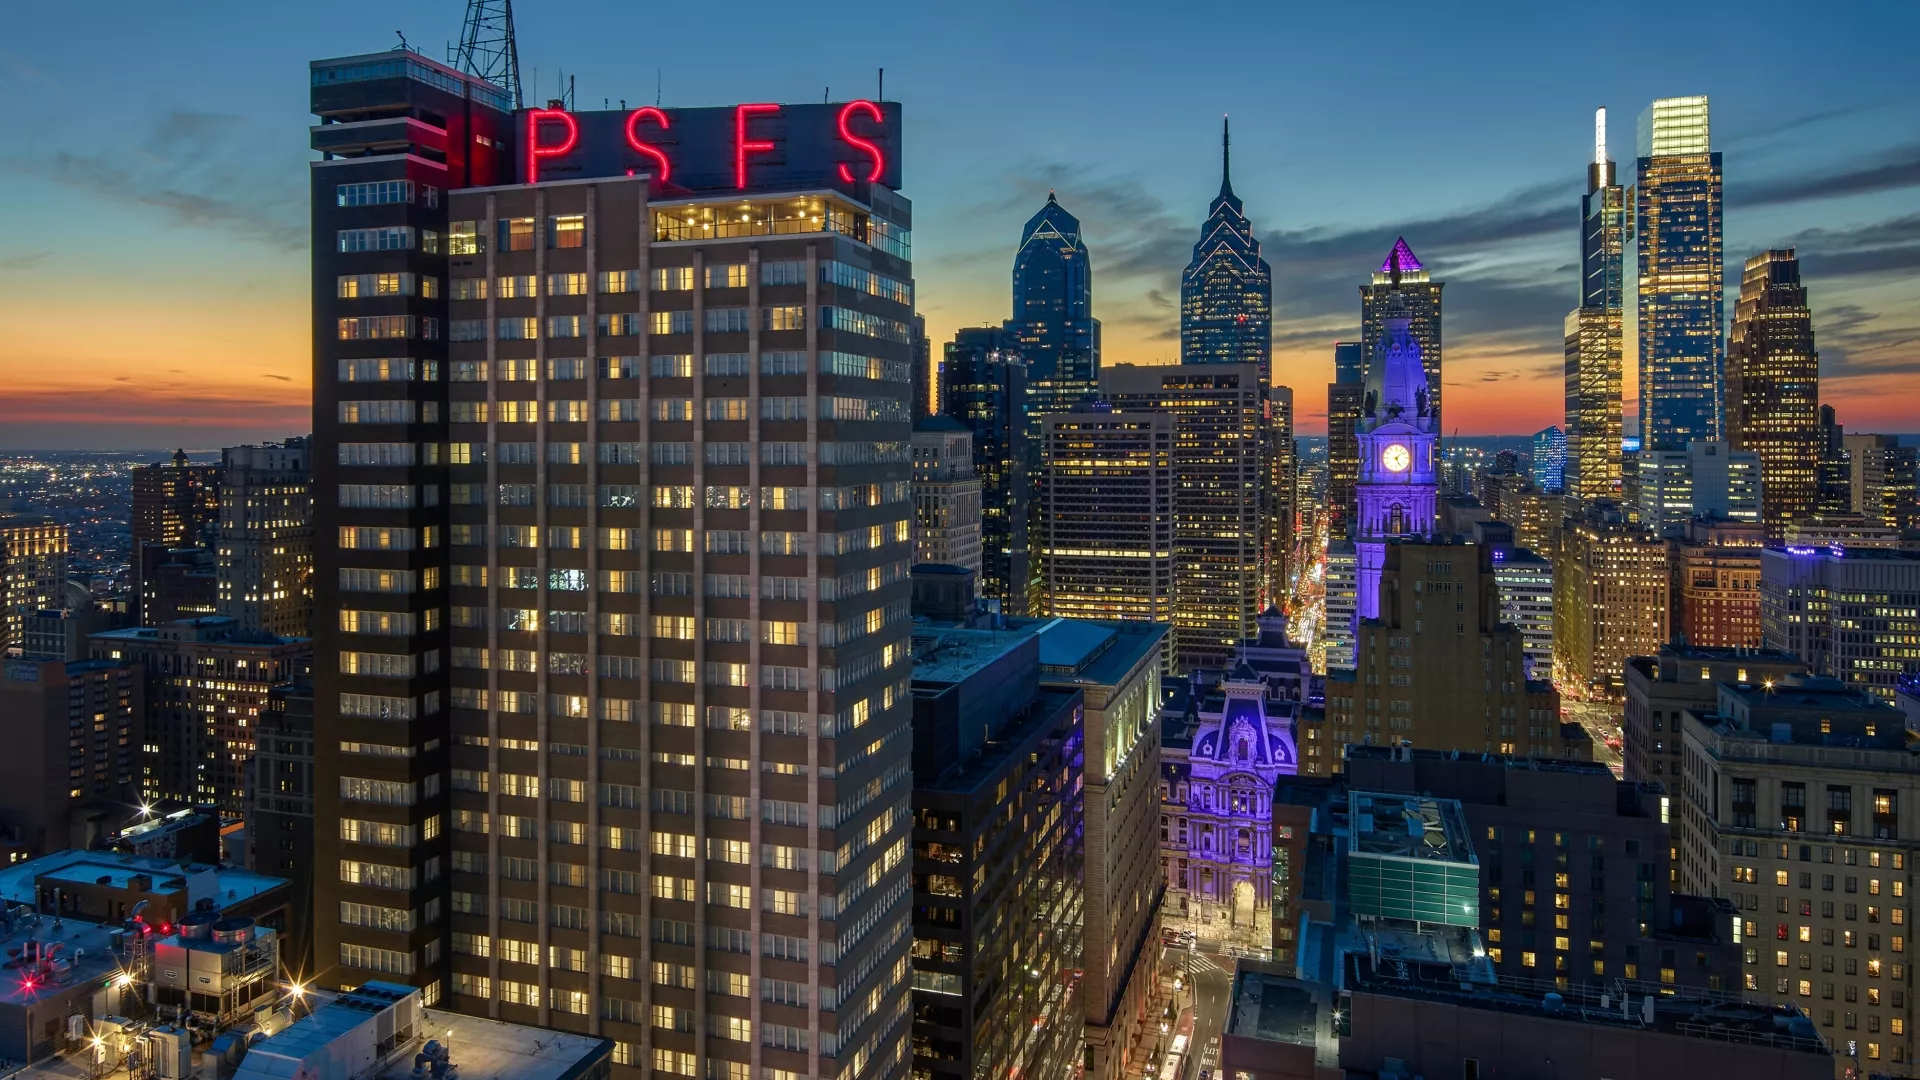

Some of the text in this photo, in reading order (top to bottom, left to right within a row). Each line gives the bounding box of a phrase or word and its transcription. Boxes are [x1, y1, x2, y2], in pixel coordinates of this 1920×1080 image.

[527, 99, 885, 189] PSFS
[1205, 1047, 1219, 1055] LEFT
[1201, 1058, 1215, 1066] TURN
